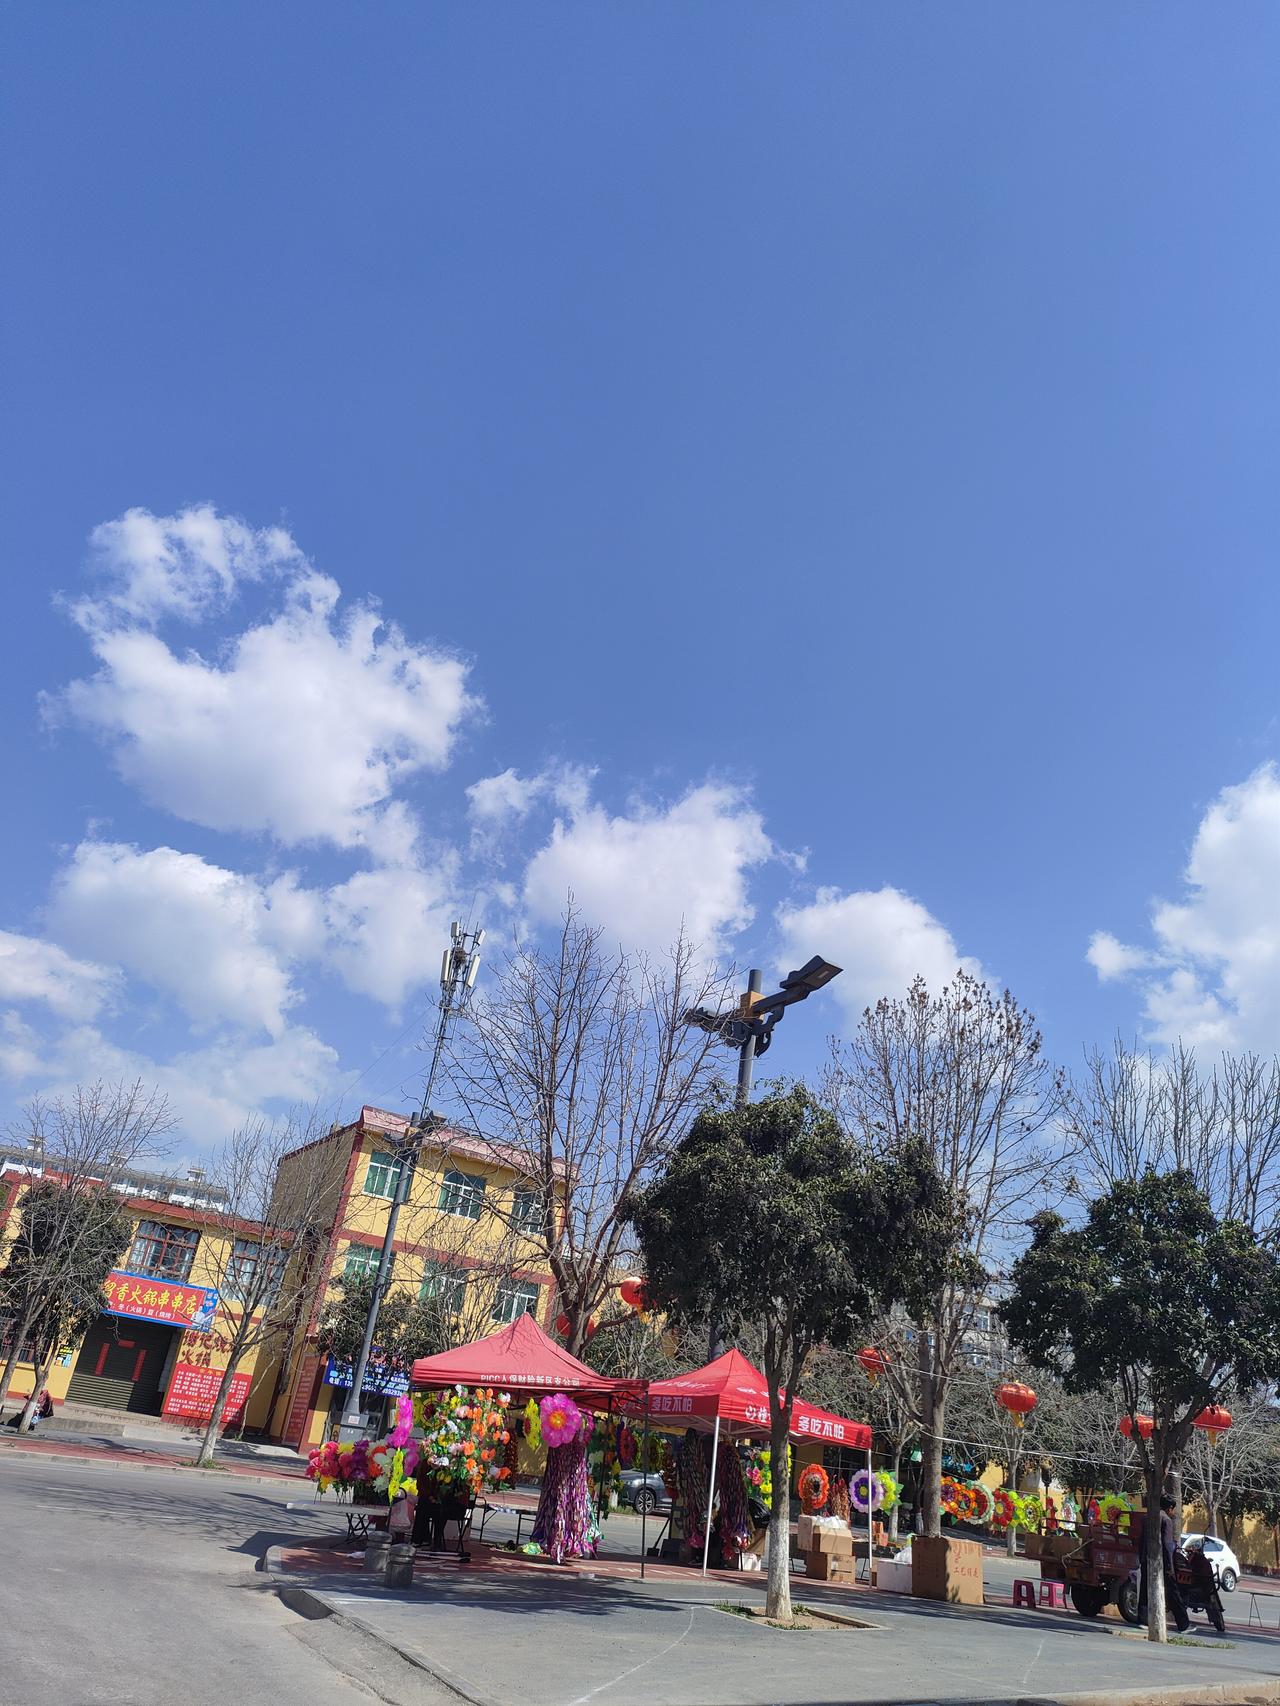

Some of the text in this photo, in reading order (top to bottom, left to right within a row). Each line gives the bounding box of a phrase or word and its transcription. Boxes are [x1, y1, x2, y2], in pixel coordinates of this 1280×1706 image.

[651, 1396, 693, 1412] 多吃不怕
[798, 1415, 845, 1440] 多吃不怕
